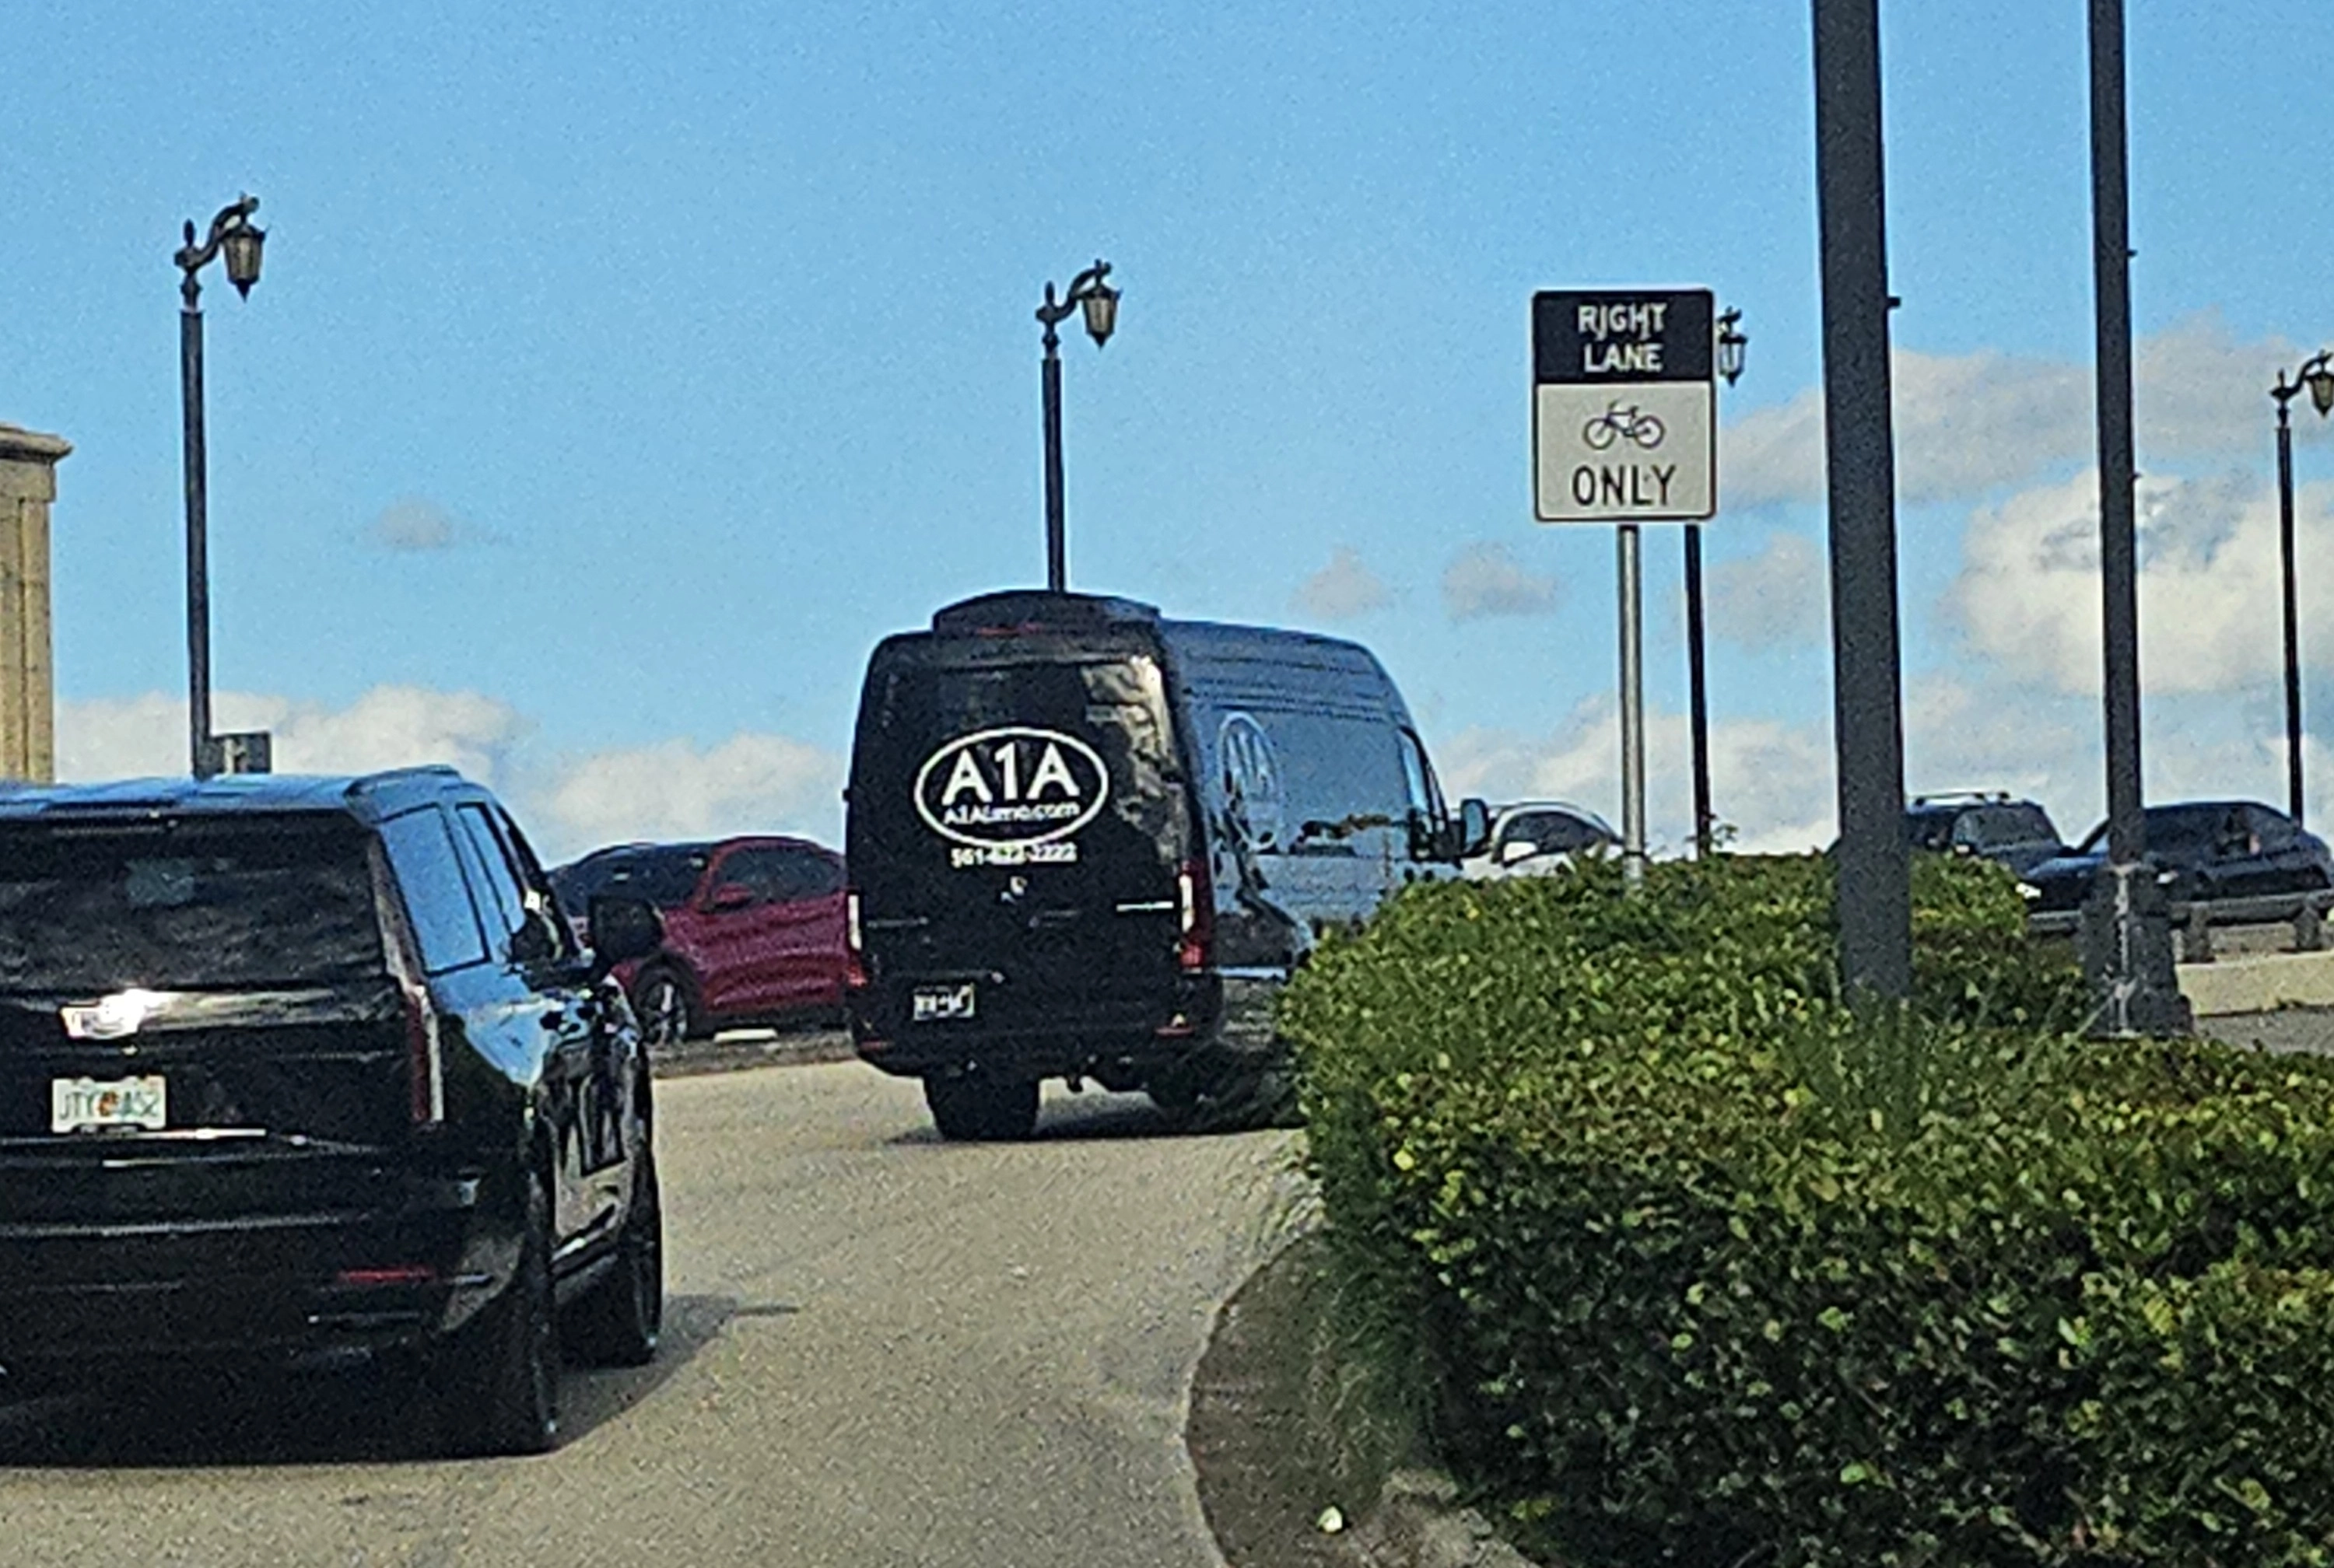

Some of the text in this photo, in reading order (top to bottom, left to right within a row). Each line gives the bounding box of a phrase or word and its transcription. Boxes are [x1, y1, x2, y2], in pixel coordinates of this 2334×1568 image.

[1578, 303, 1666, 341] RIGHT
[1584, 343, 1663, 373] LANE
[1572, 464, 1676, 506] ONLY
[942, 742, 1080, 806] A1A
